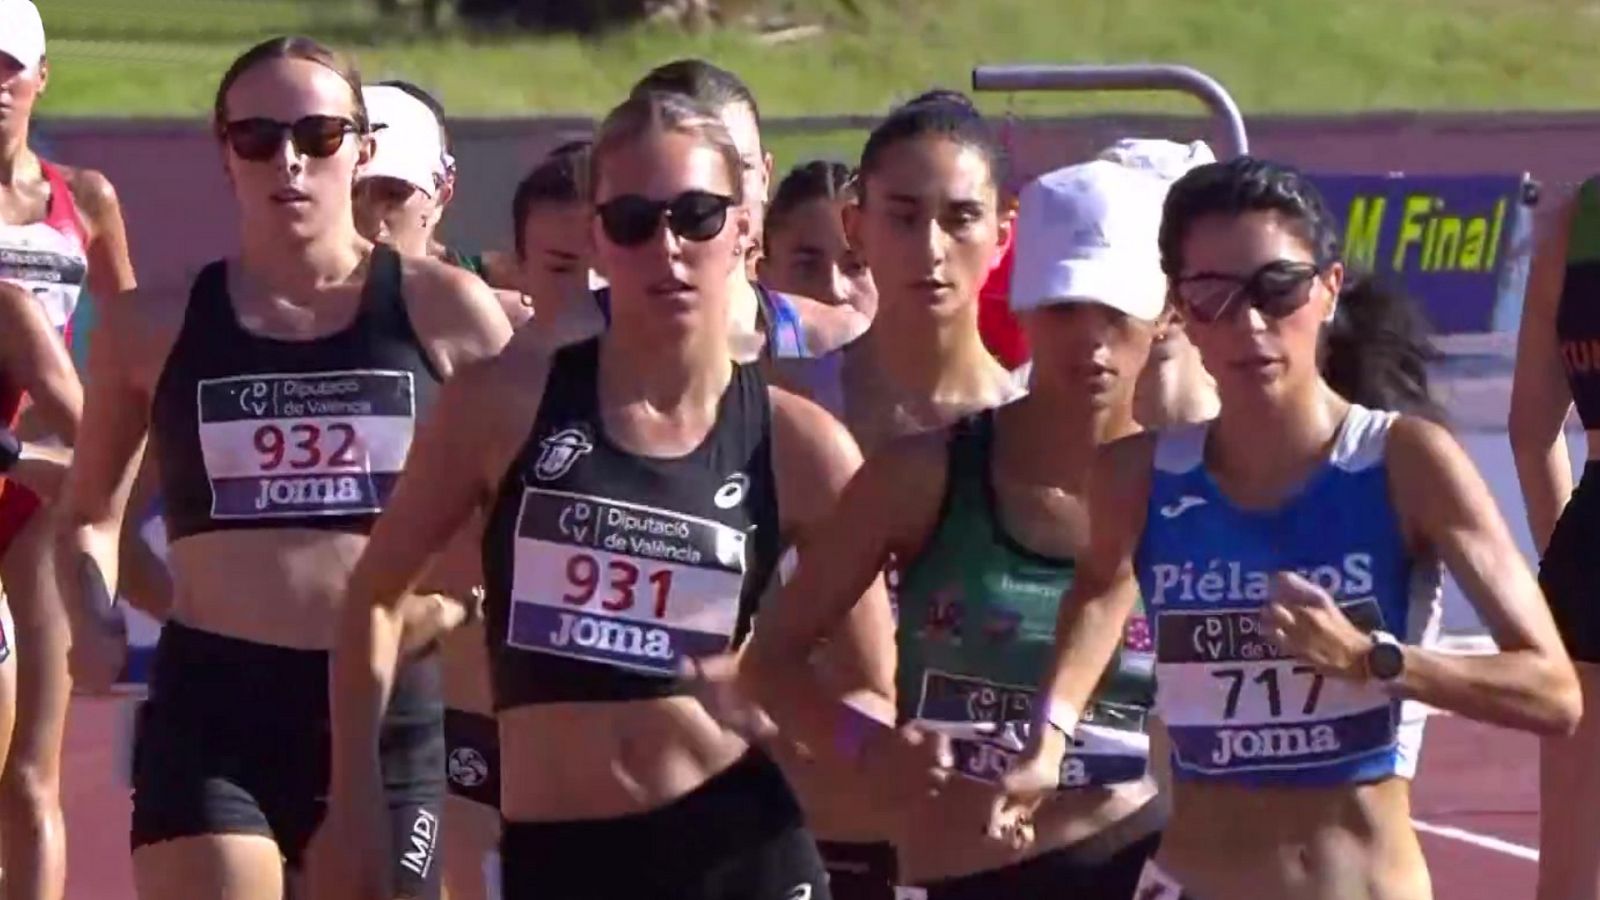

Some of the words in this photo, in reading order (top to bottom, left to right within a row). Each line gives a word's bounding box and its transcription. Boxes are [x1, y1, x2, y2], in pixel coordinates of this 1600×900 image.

[1393, 193, 1508, 273] Final
[253, 422, 358, 471] 932
[604, 533, 626, 551] de
[607, 508, 690, 539] Diputació
[562, 553, 674, 619] 931
[1211, 665, 1325, 719] 717
